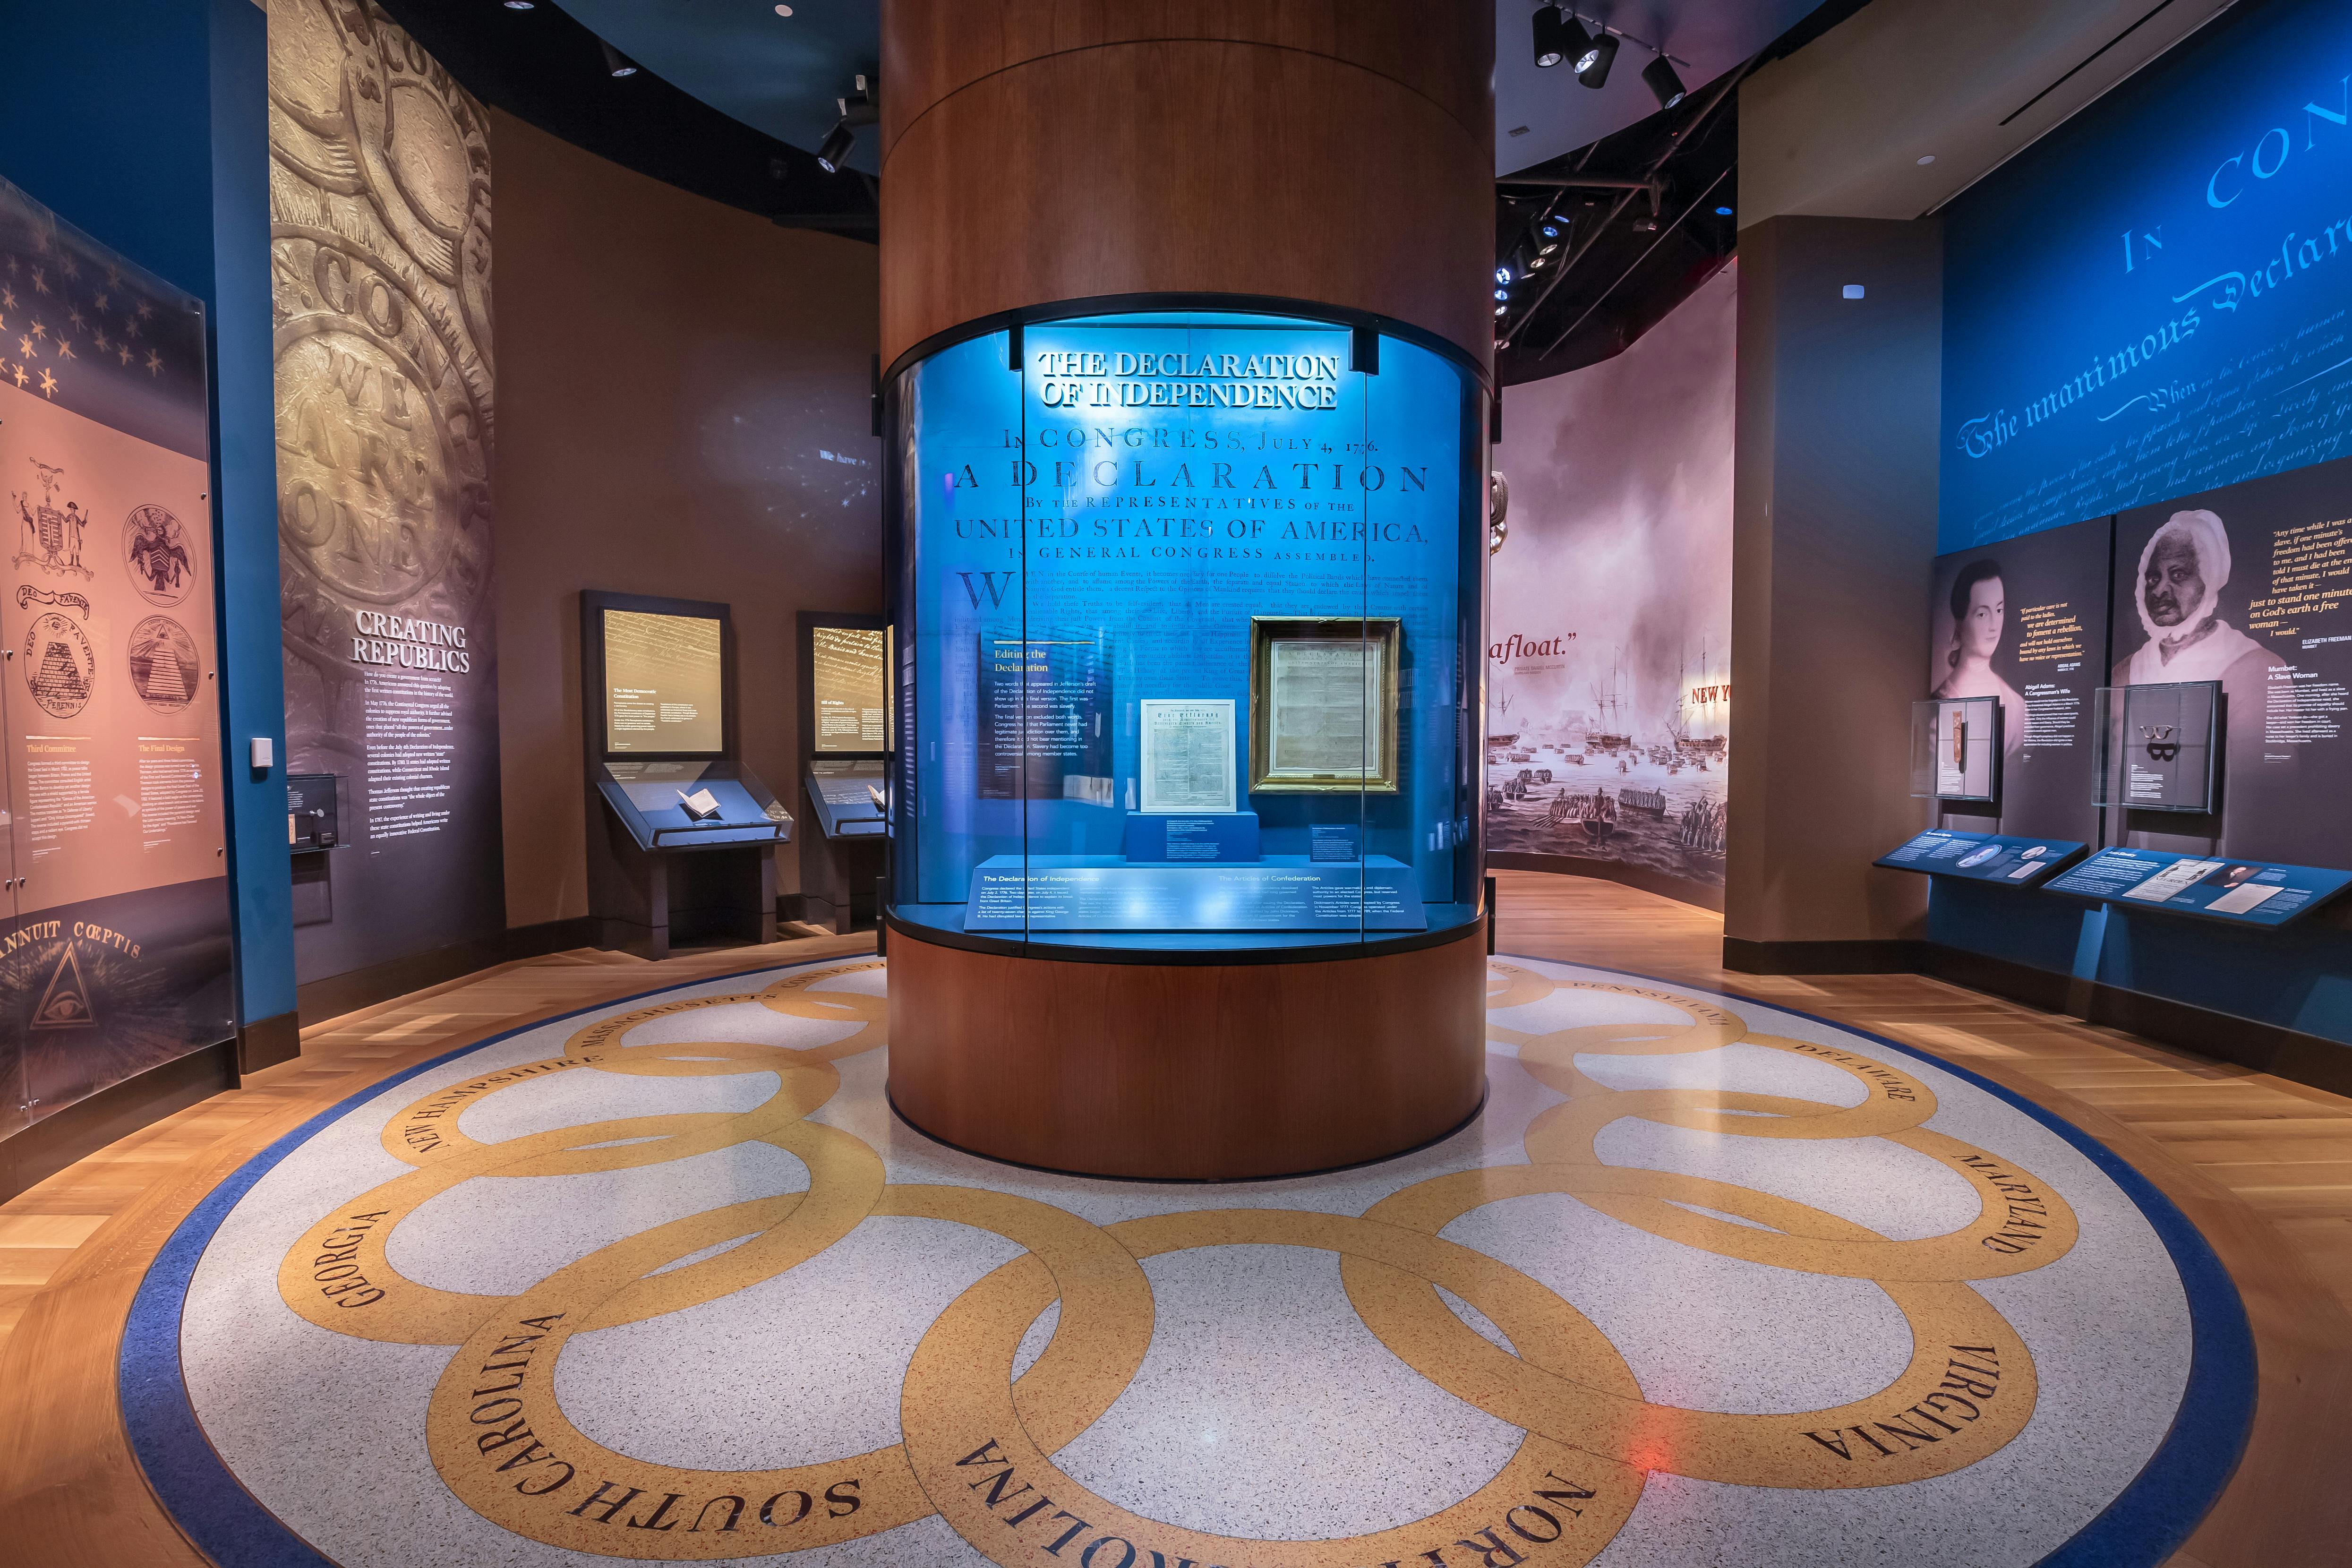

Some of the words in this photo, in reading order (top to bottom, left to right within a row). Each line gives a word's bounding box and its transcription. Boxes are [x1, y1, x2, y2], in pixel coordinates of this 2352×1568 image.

[2207, 74, 2352, 208] CON
[1038, 352, 1107, 377] THE
[1114, 352, 1339, 381] DECLARATION
[313, 337, 412, 430] WE
[1041, 382, 1083, 407] OF
[1090, 383, 1337, 410] INDEPENDENCE
[1956, 409, 2018, 458] The
[2025, 307, 2200, 428] unanimous
[276, 398, 434, 511] ARE
[1040, 427, 1245, 453] CONGRESS,
[1321, 441, 1332, 454] 4,
[954, 464, 979, 488] A
[1011, 461, 1428, 492] DECLARATION
[1052, 500, 1078, 508] THE
[1086, 496, 1295, 509] REPRESENTATIVES
[1328, 503, 1354, 512] THE
[284, 477, 420, 576] ONE
[954, 518, 1079, 539] UNITED
[1094, 518, 1213, 538] STATES
[1227, 519, 1266, 538] OF
[1281, 521, 1428, 546] AMERICA,
[2293, 536, 2301, 545] if
[2307, 522, 2325, 531] while
[1040, 547, 1140, 558] GENERAL
[1152, 547, 1263, 559] CONGRESS
[2273, 548, 2300, 558] freedom
[2316, 541, 2332, 549] been
[2328, 549, 2345, 557] been
[22, 587, 37, 597] DEO
[2249, 600, 2266, 610] just
[2278, 592, 2302, 604] stand
[2045, 616, 2076, 626] determined
[2287, 603, 2310, 613] earth
[2319, 601, 2339, 612] free
[26, 631, 36, 657] DEO
[356, 610, 466, 650] CREATING
[2032, 628, 2052, 638] foment
[2057, 625, 2083, 634] rebellion,
[69, 623, 94, 675] FAVENTE
[351, 638, 470, 674] REPUBLICS
[1032, 649, 1046, 658] the
[1692, 685, 1719, 704] NEW
[26, 745, 43, 753] Third
[44, 745, 76, 753] Committee
[1574, 983, 1731, 1026] PENNSYLVANIA
[581, 994, 778, 1048] MASSACHUSETTS
[411, 1055, 605, 1120] HAMPSHIRE
[1793, 1044, 1915, 1102] DELAWARE
[405, 1124, 451, 1153] NEW
[1950, 1154, 2047, 1254] MARYLAND
[314, 1209, 391, 1308] GEORGIA
[470, 1312, 575, 1496] CAROLINA
[1799, 1345, 2001, 1460] VIRGINIA
[567, 1479, 863, 1533] SOUTH
[1378, 1470, 1597, 1568] NOR
